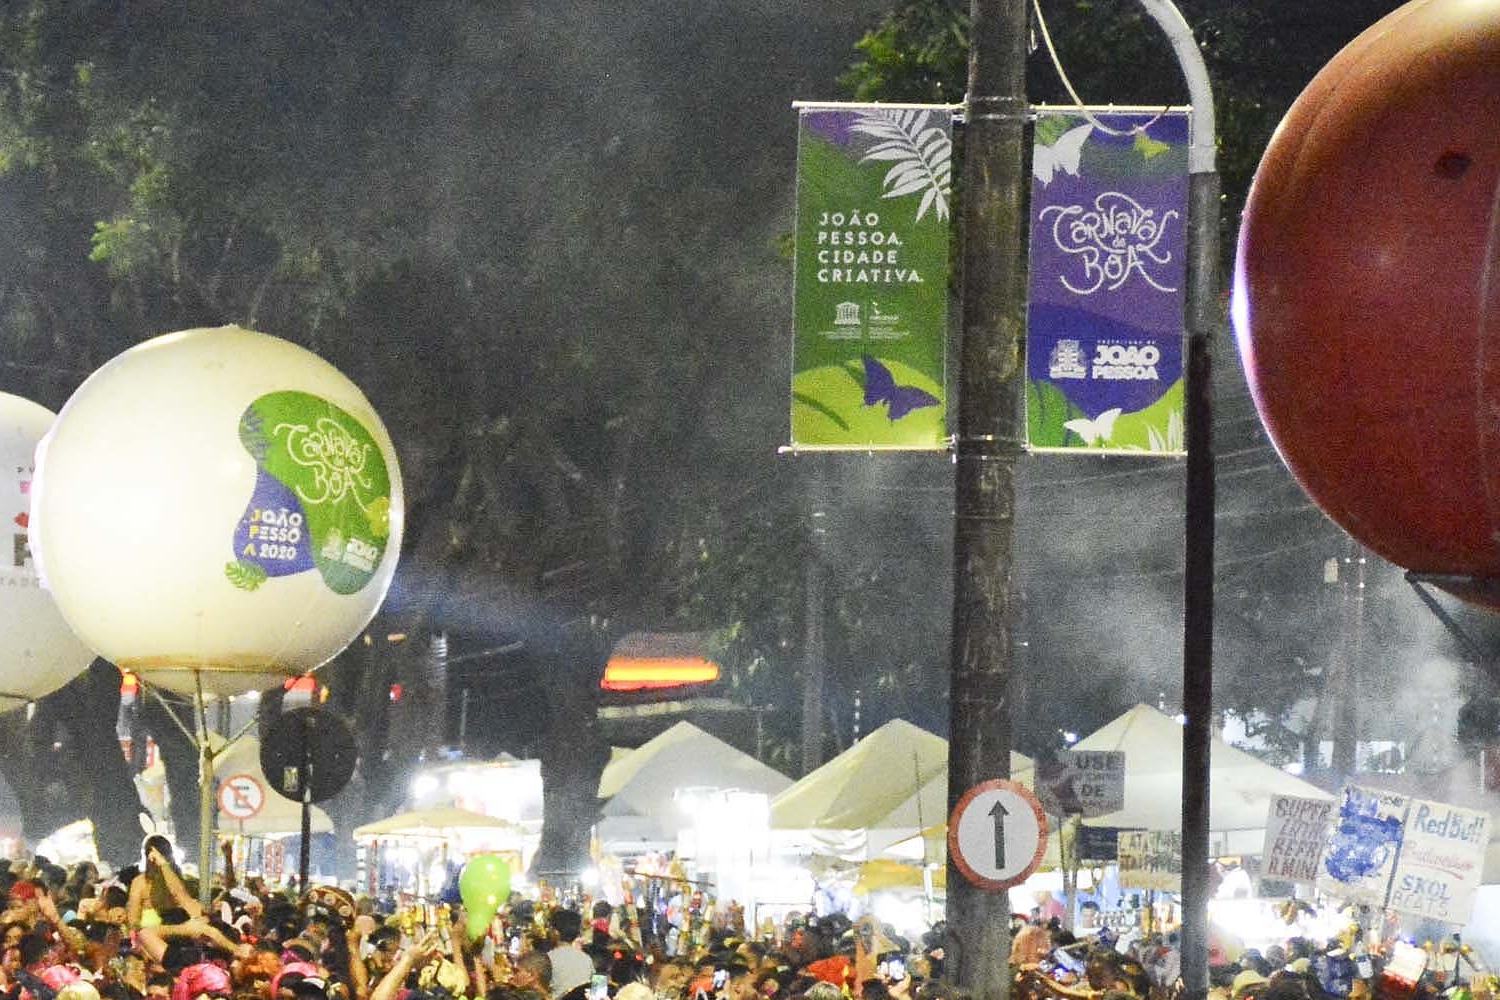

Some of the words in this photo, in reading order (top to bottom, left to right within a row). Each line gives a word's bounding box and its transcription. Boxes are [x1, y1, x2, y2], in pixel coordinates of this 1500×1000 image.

[818, 209, 879, 226] JOÃO
[817, 249, 897, 264] CIDADE
[1091, 365, 1159, 380] PESSOA
[250, 507, 303, 527] JOÃO
[249, 524, 301, 543] PESSO
[259, 543, 298, 561] 2020
[1401, 874, 1451, 901] SKOL
